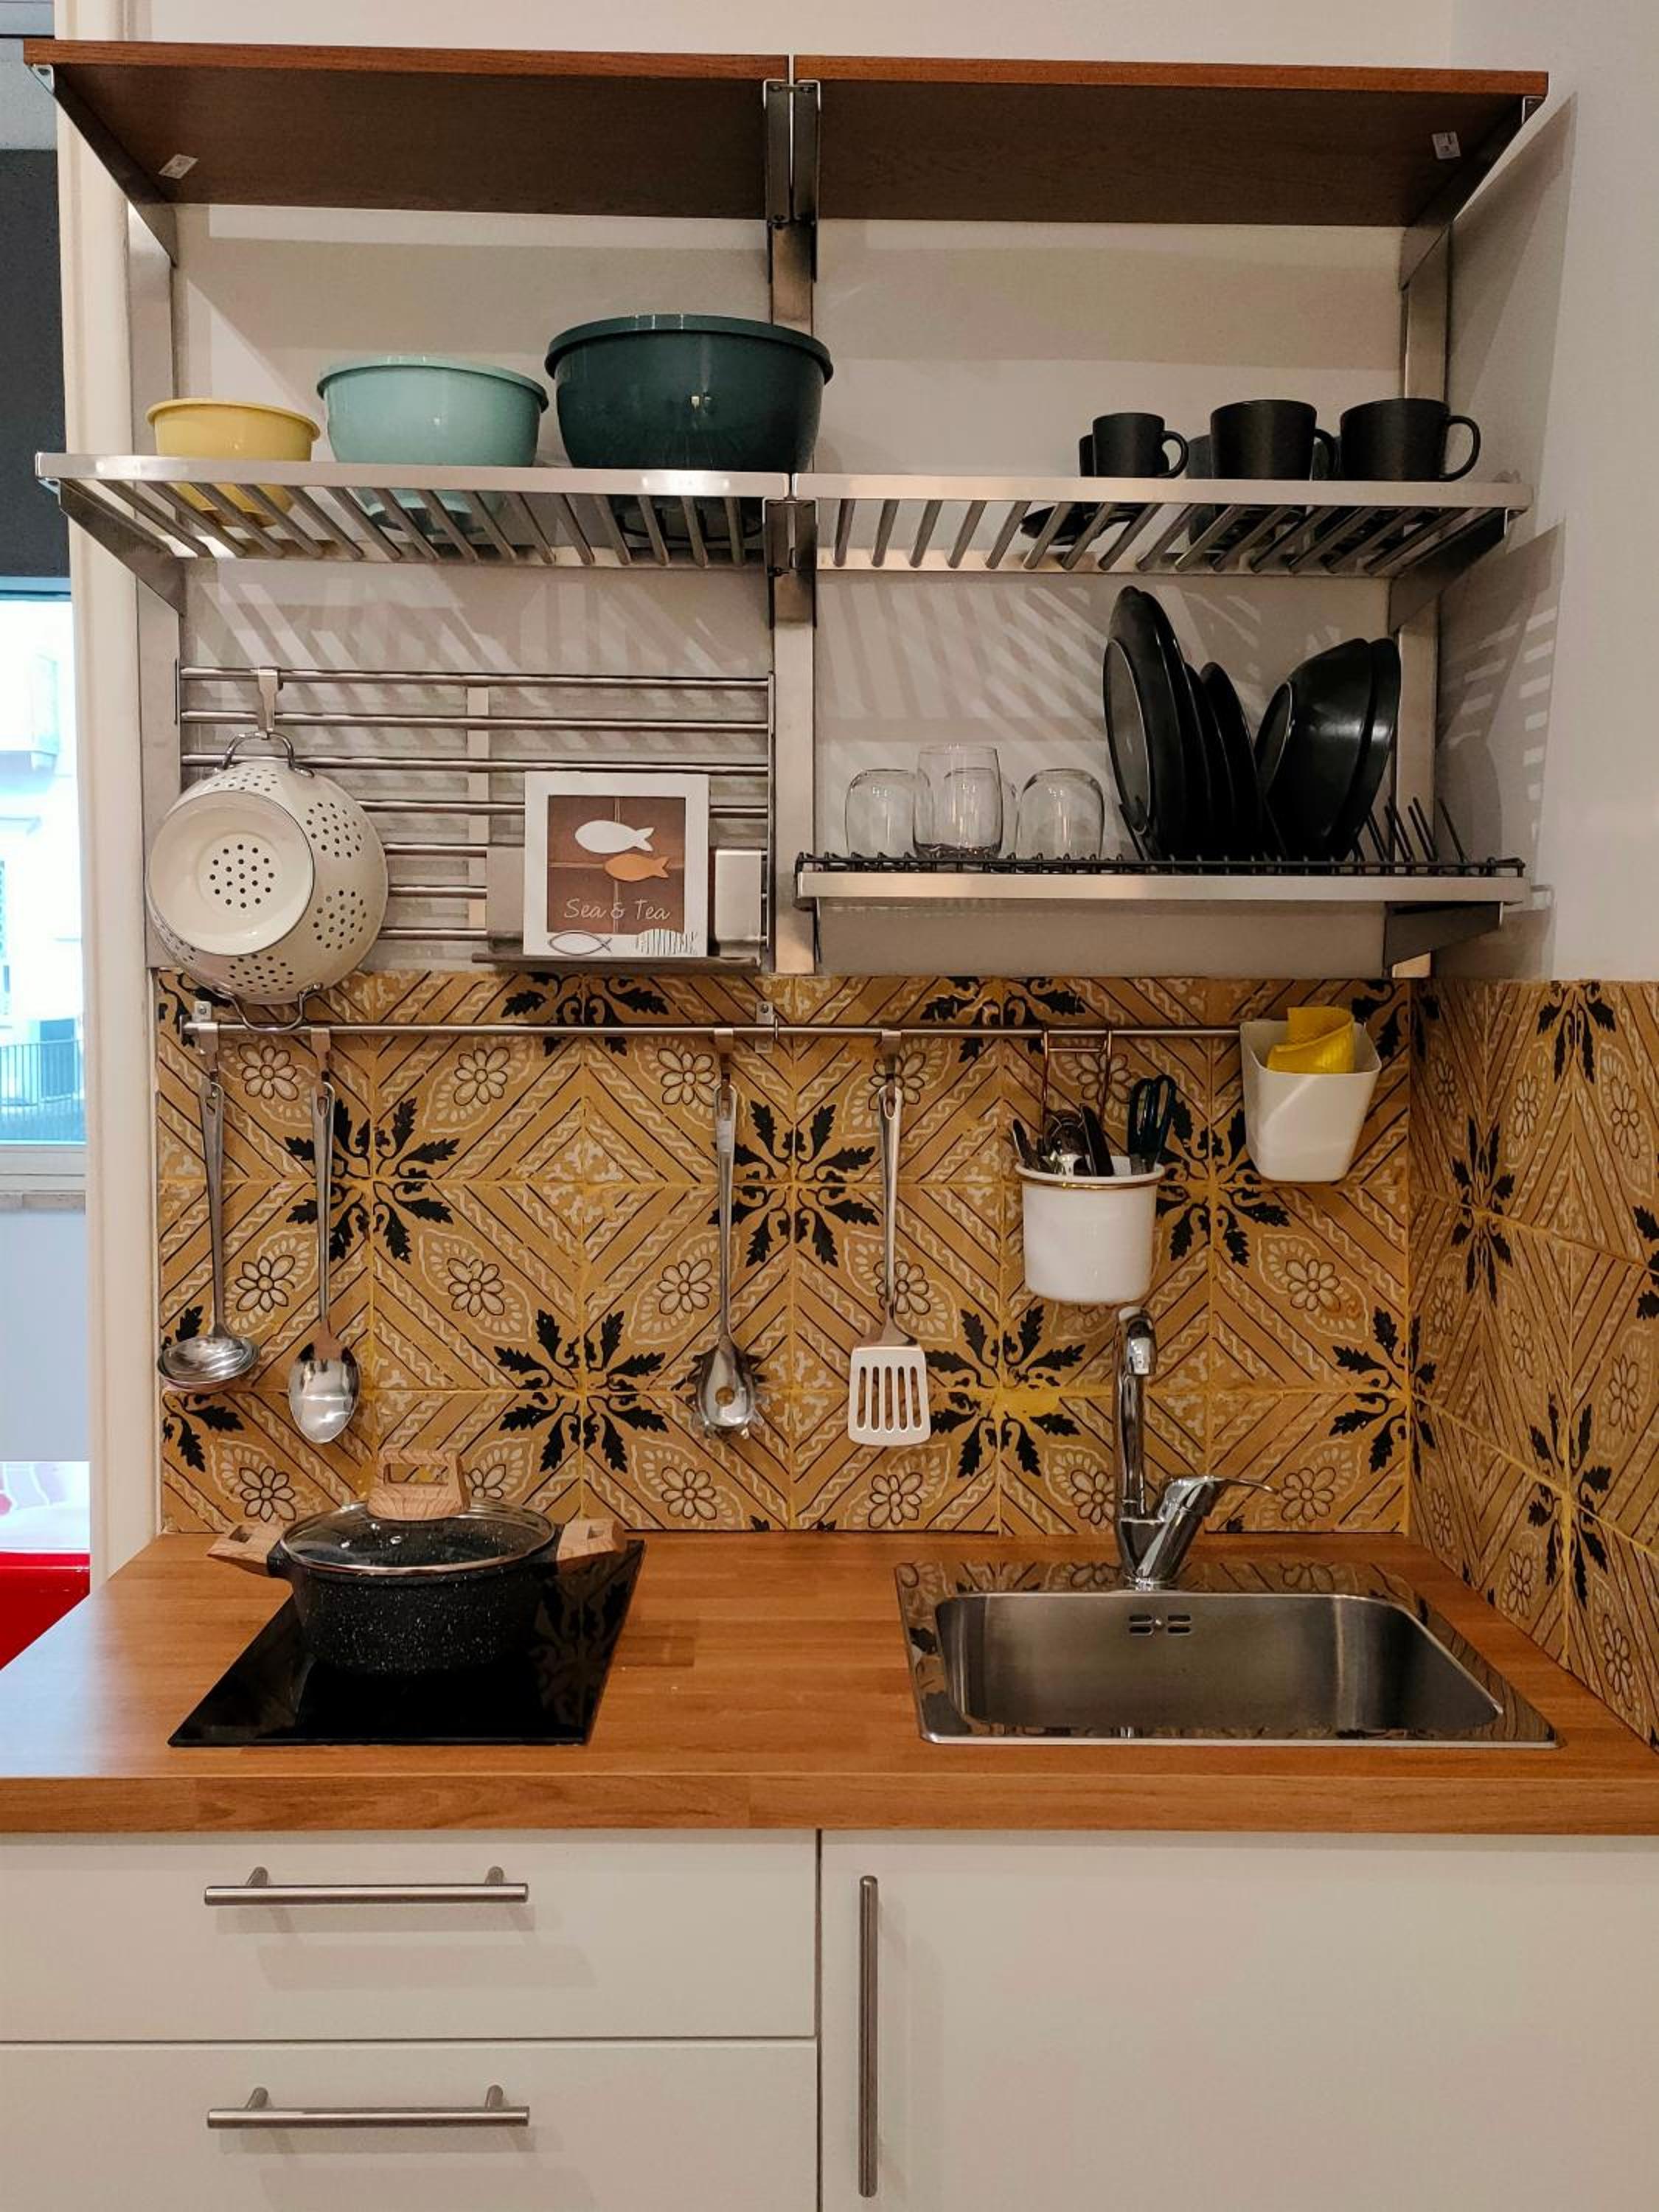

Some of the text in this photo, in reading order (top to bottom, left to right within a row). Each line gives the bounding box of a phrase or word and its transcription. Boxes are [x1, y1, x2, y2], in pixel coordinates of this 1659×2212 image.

[564, 898, 670, 920] Sea & Tea
